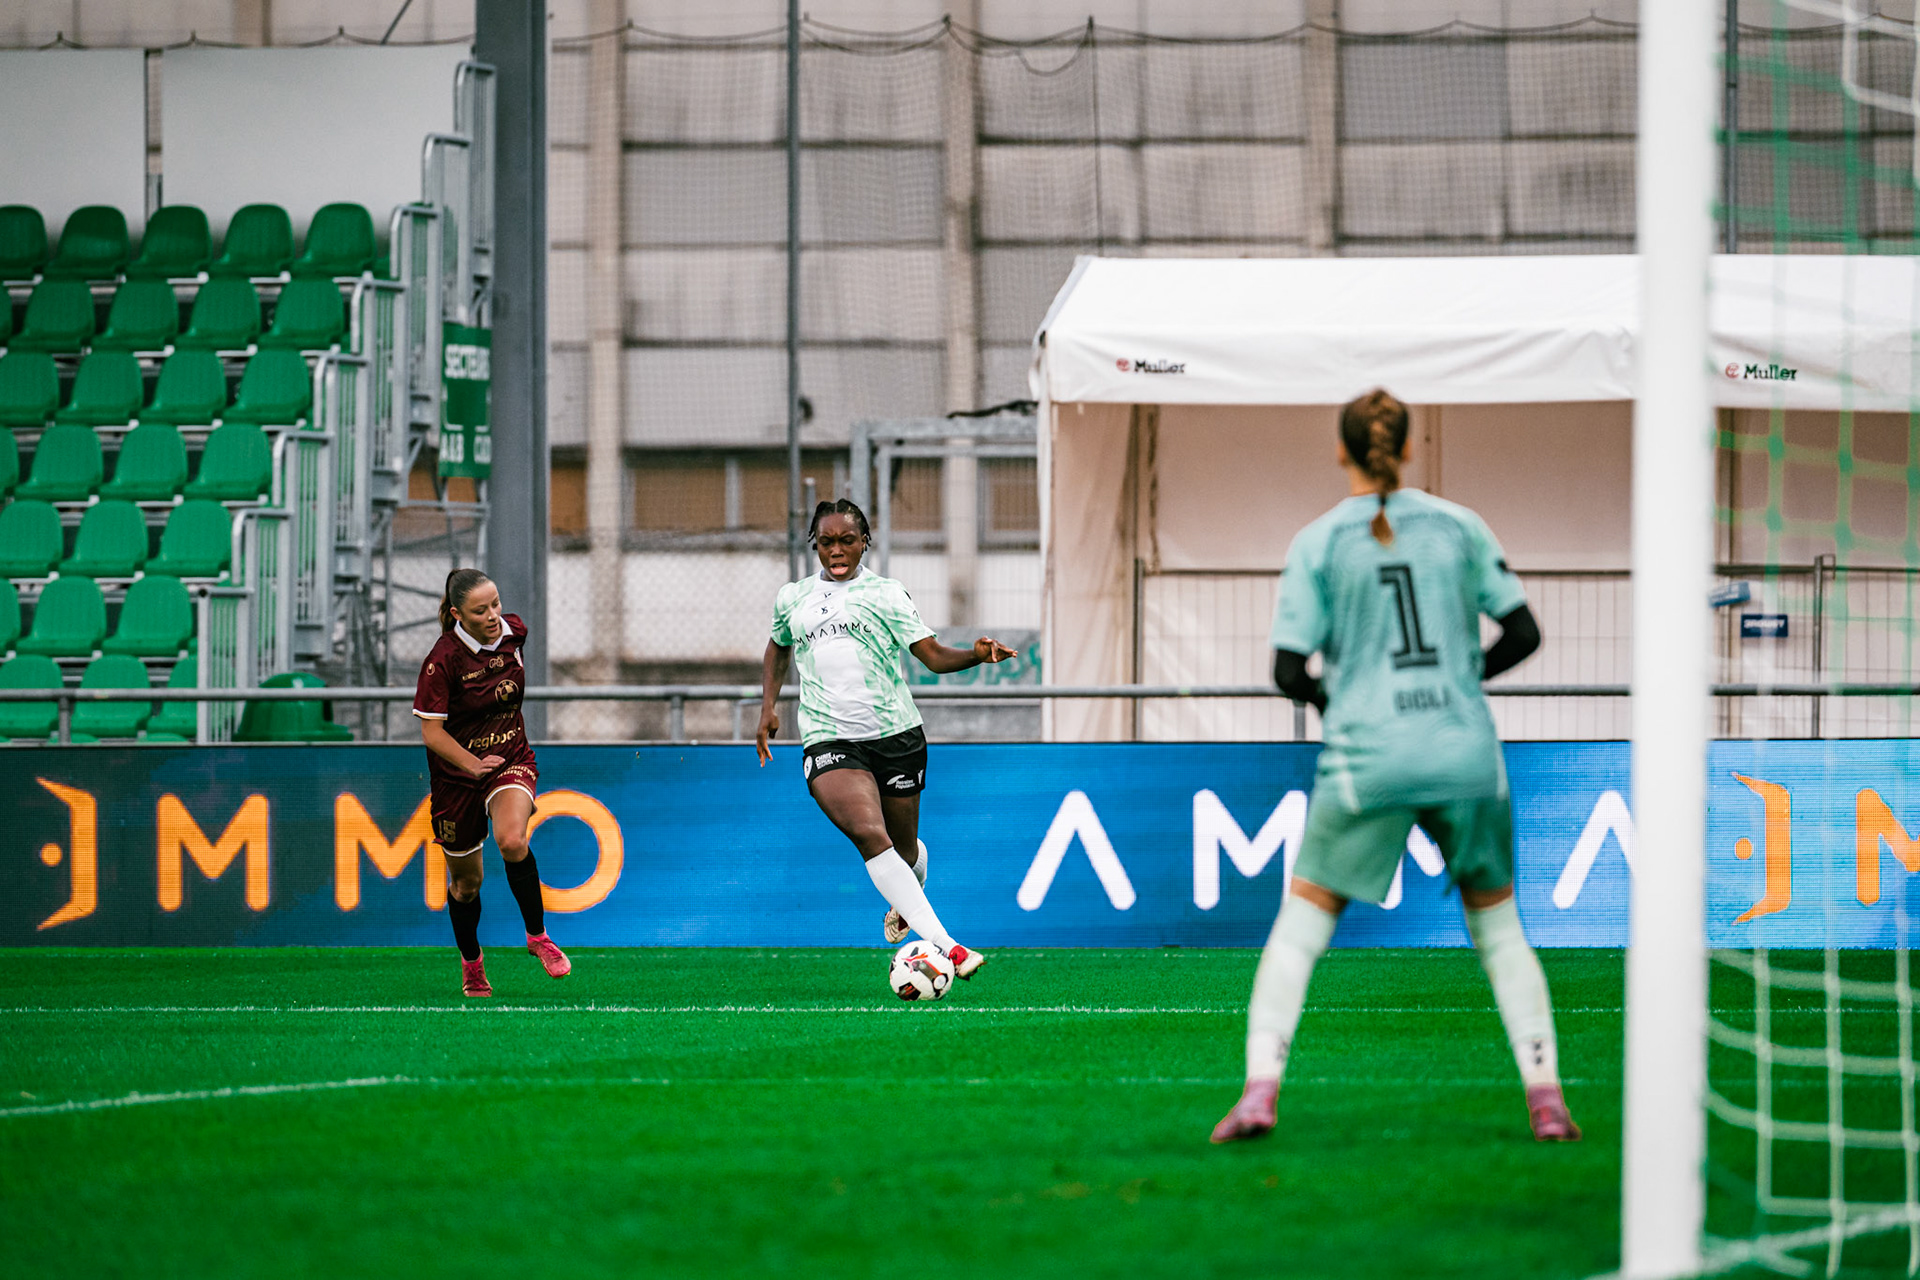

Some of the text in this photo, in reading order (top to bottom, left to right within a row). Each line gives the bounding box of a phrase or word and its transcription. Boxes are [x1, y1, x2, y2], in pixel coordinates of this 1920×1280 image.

[1134, 359, 1185, 374] Muller
[1743, 363, 1798, 381] Muller
[1378, 563, 1440, 670] 1
